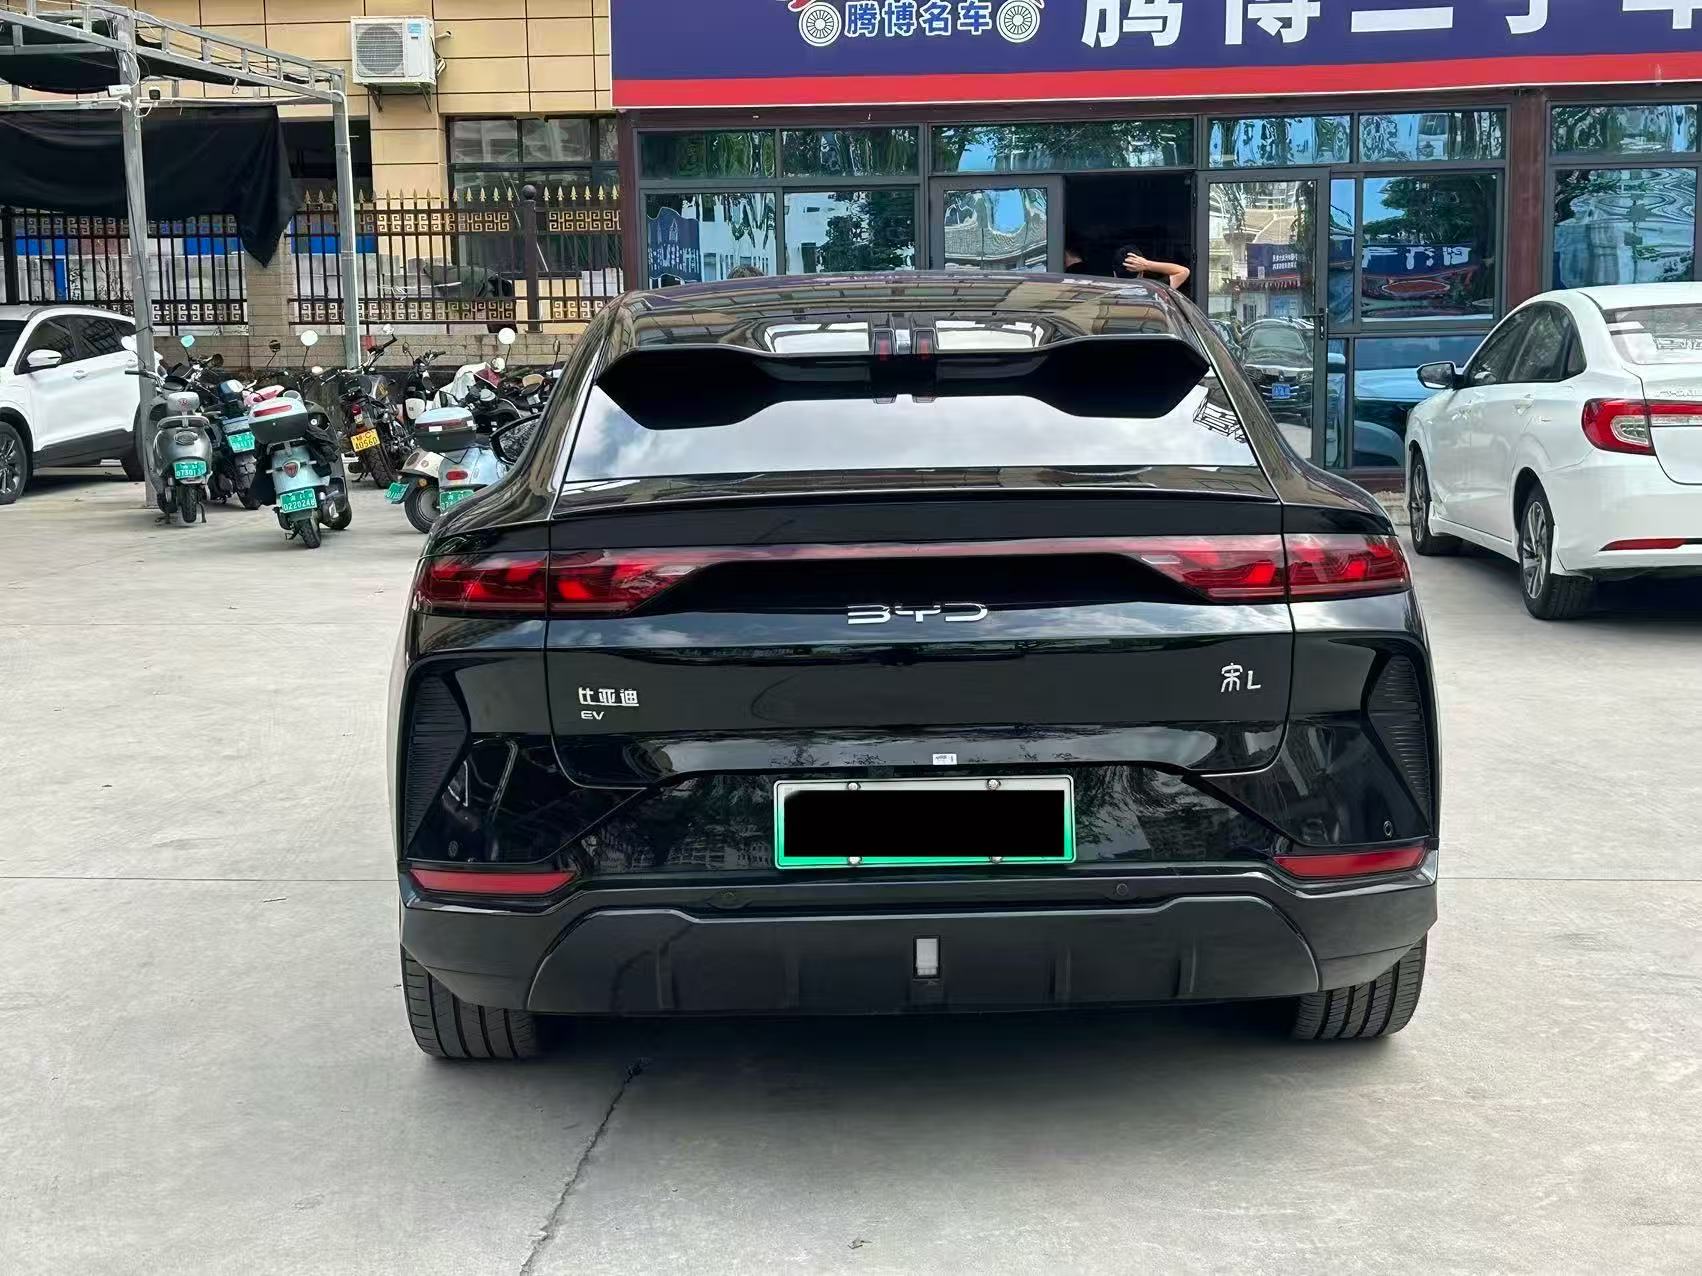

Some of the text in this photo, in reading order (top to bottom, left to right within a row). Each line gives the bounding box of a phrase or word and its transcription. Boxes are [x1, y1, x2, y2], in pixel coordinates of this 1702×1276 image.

[844, 0, 993, 38] 腾博名车
[847, 603, 988, 625] BYD
[578, 687, 640, 707] 比亚迪
[580, 710, 605, 720] EV
